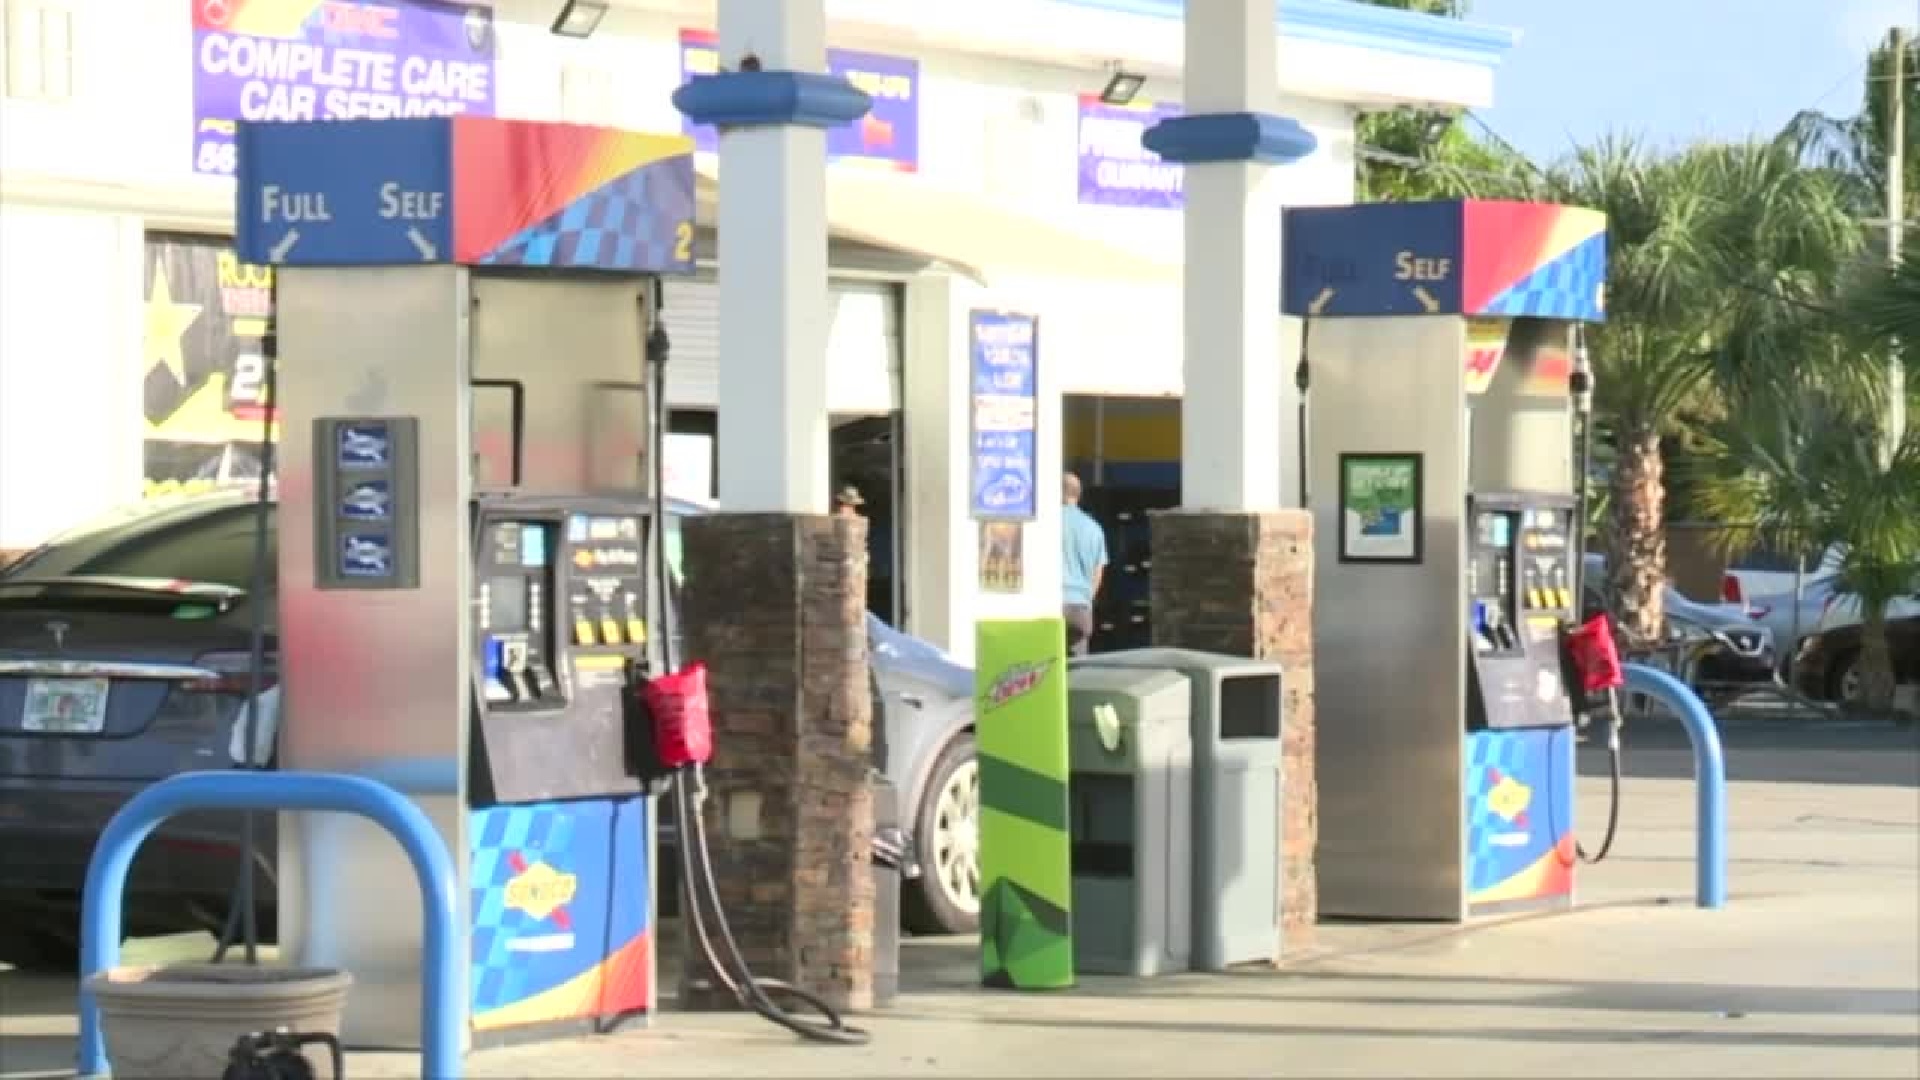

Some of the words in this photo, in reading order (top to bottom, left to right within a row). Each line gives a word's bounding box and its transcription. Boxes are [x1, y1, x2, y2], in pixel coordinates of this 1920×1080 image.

[200, 34, 396, 90] COMPLETE
[403, 56, 488, 101] CARE
[240, 80, 316, 121] CAR
[261, 185, 331, 223] FULL
[379, 182, 443, 220] SELF
[675, 222, 694, 262] 2
[1395, 252, 1451, 280] SELF
